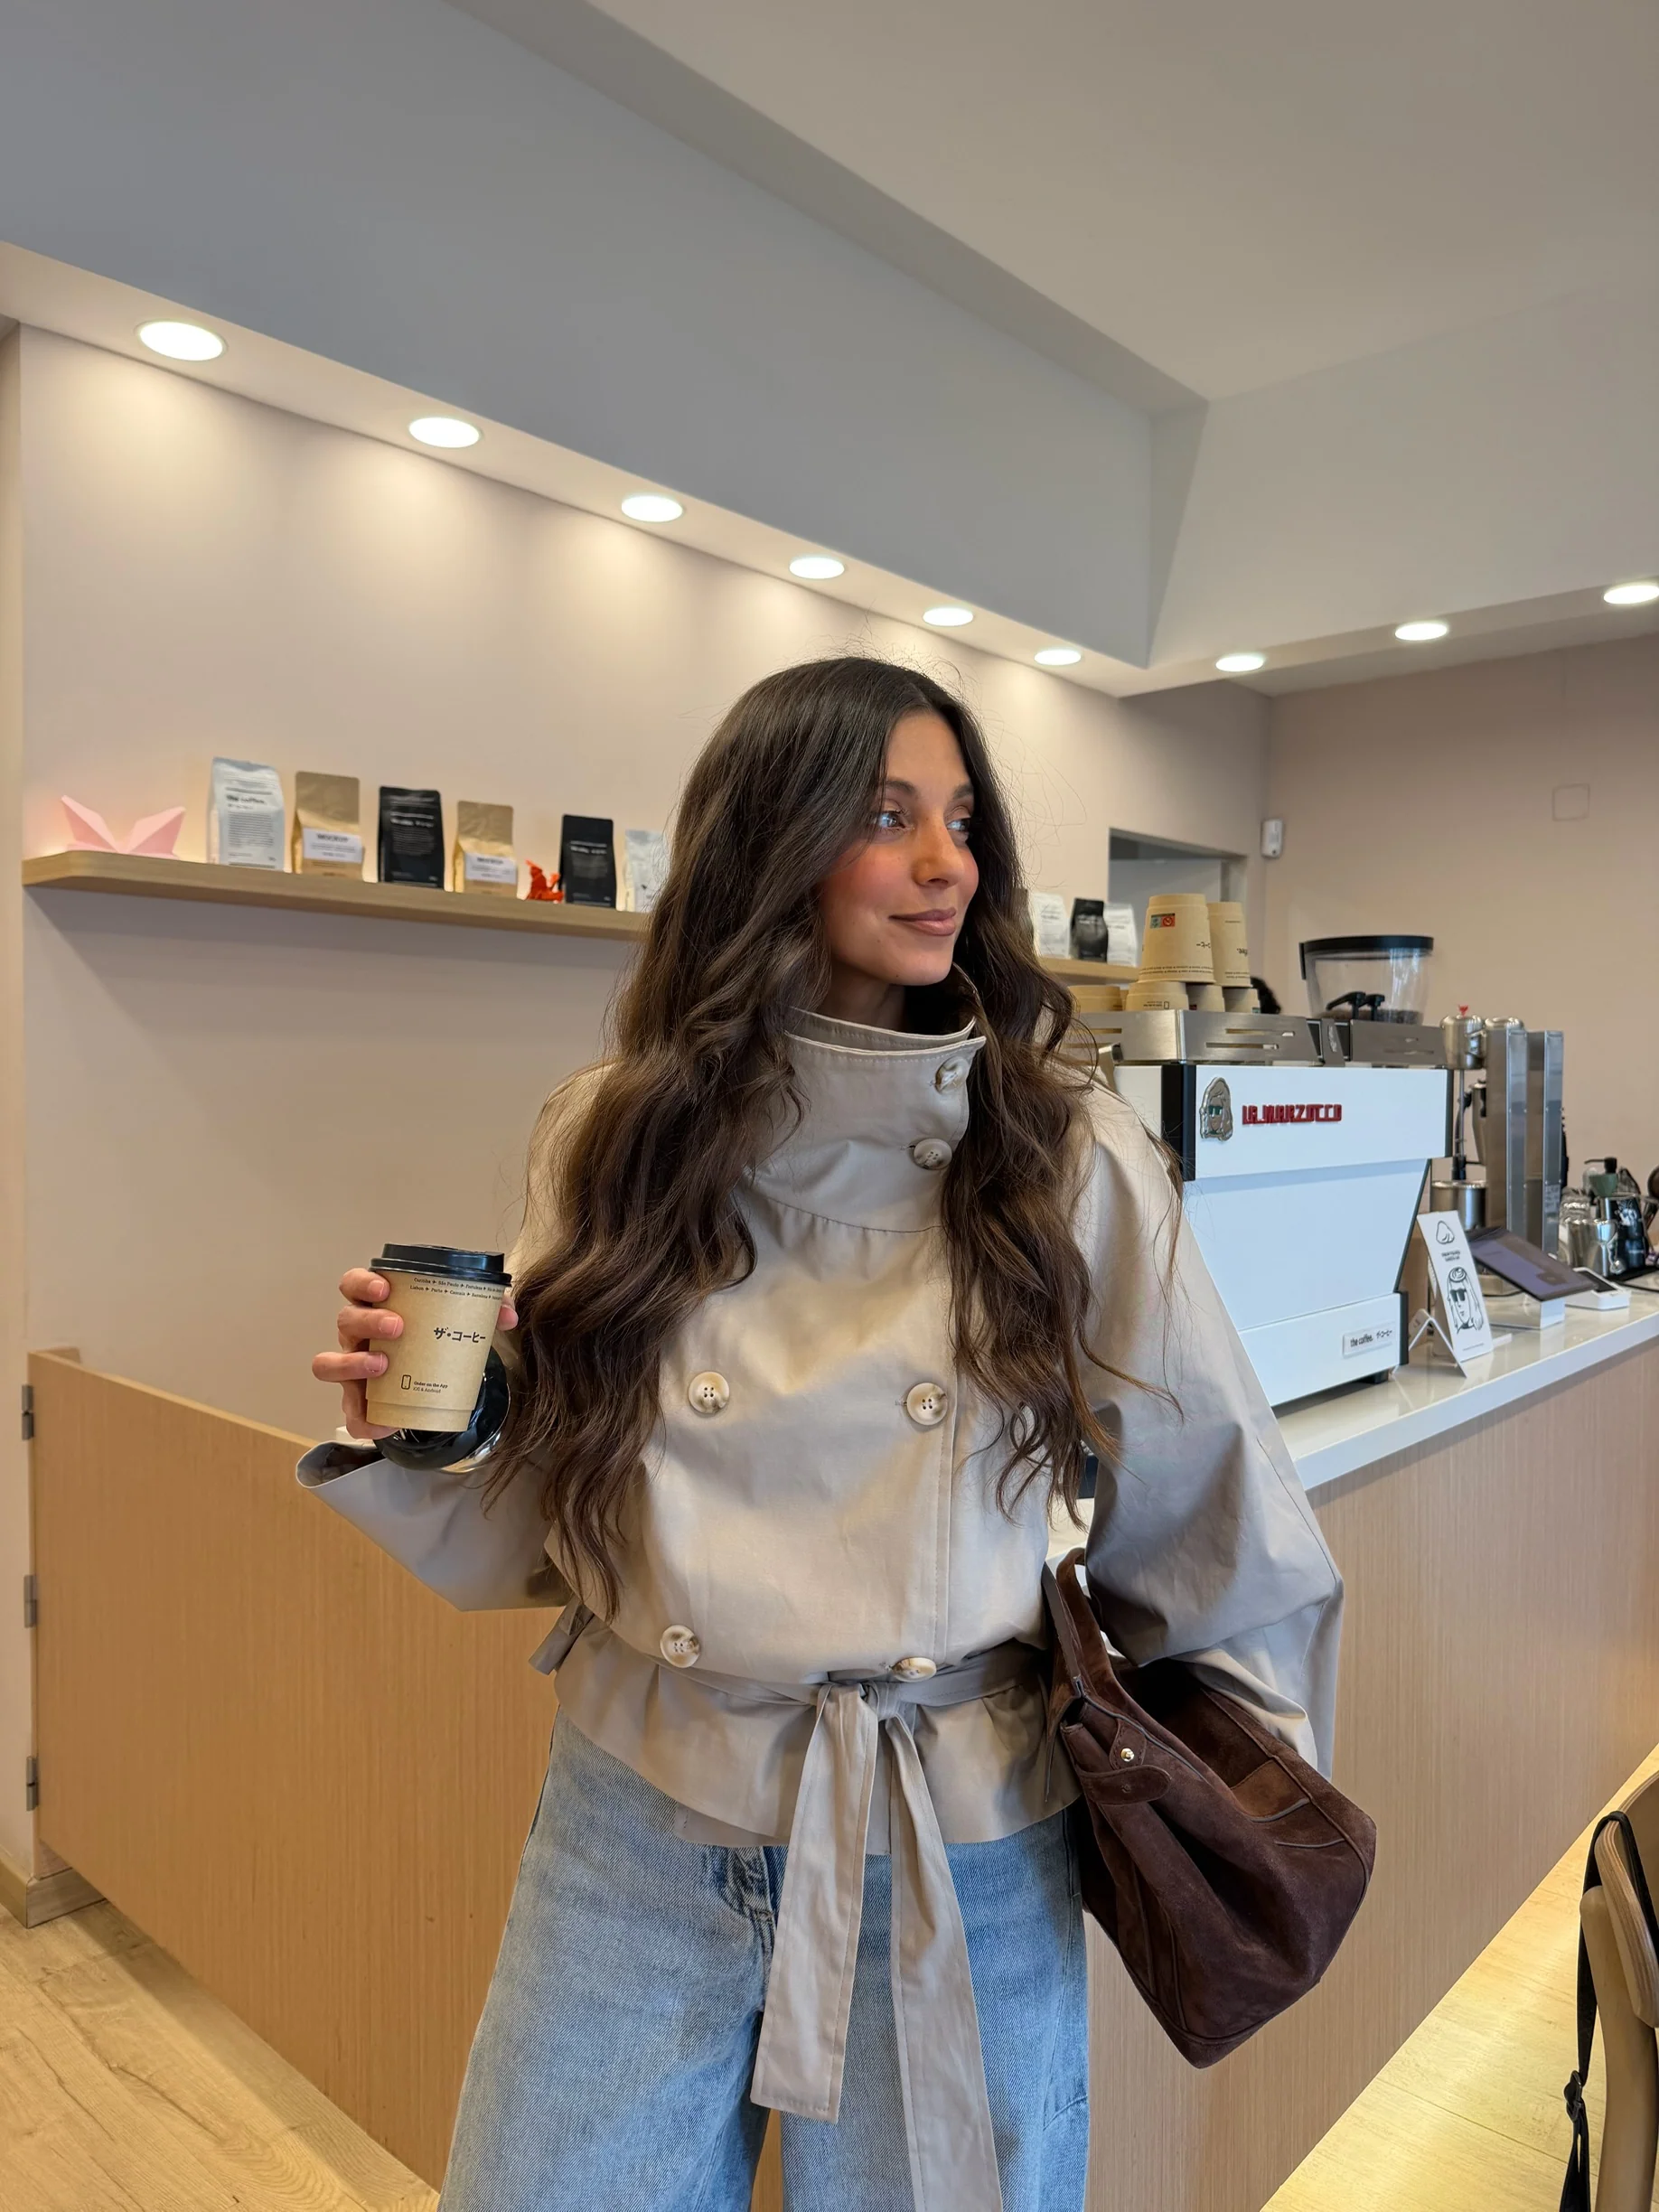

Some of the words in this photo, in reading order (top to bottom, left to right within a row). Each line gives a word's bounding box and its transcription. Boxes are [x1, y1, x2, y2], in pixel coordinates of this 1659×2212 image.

[433, 1326, 486, 1344] ザ・コーヒー
